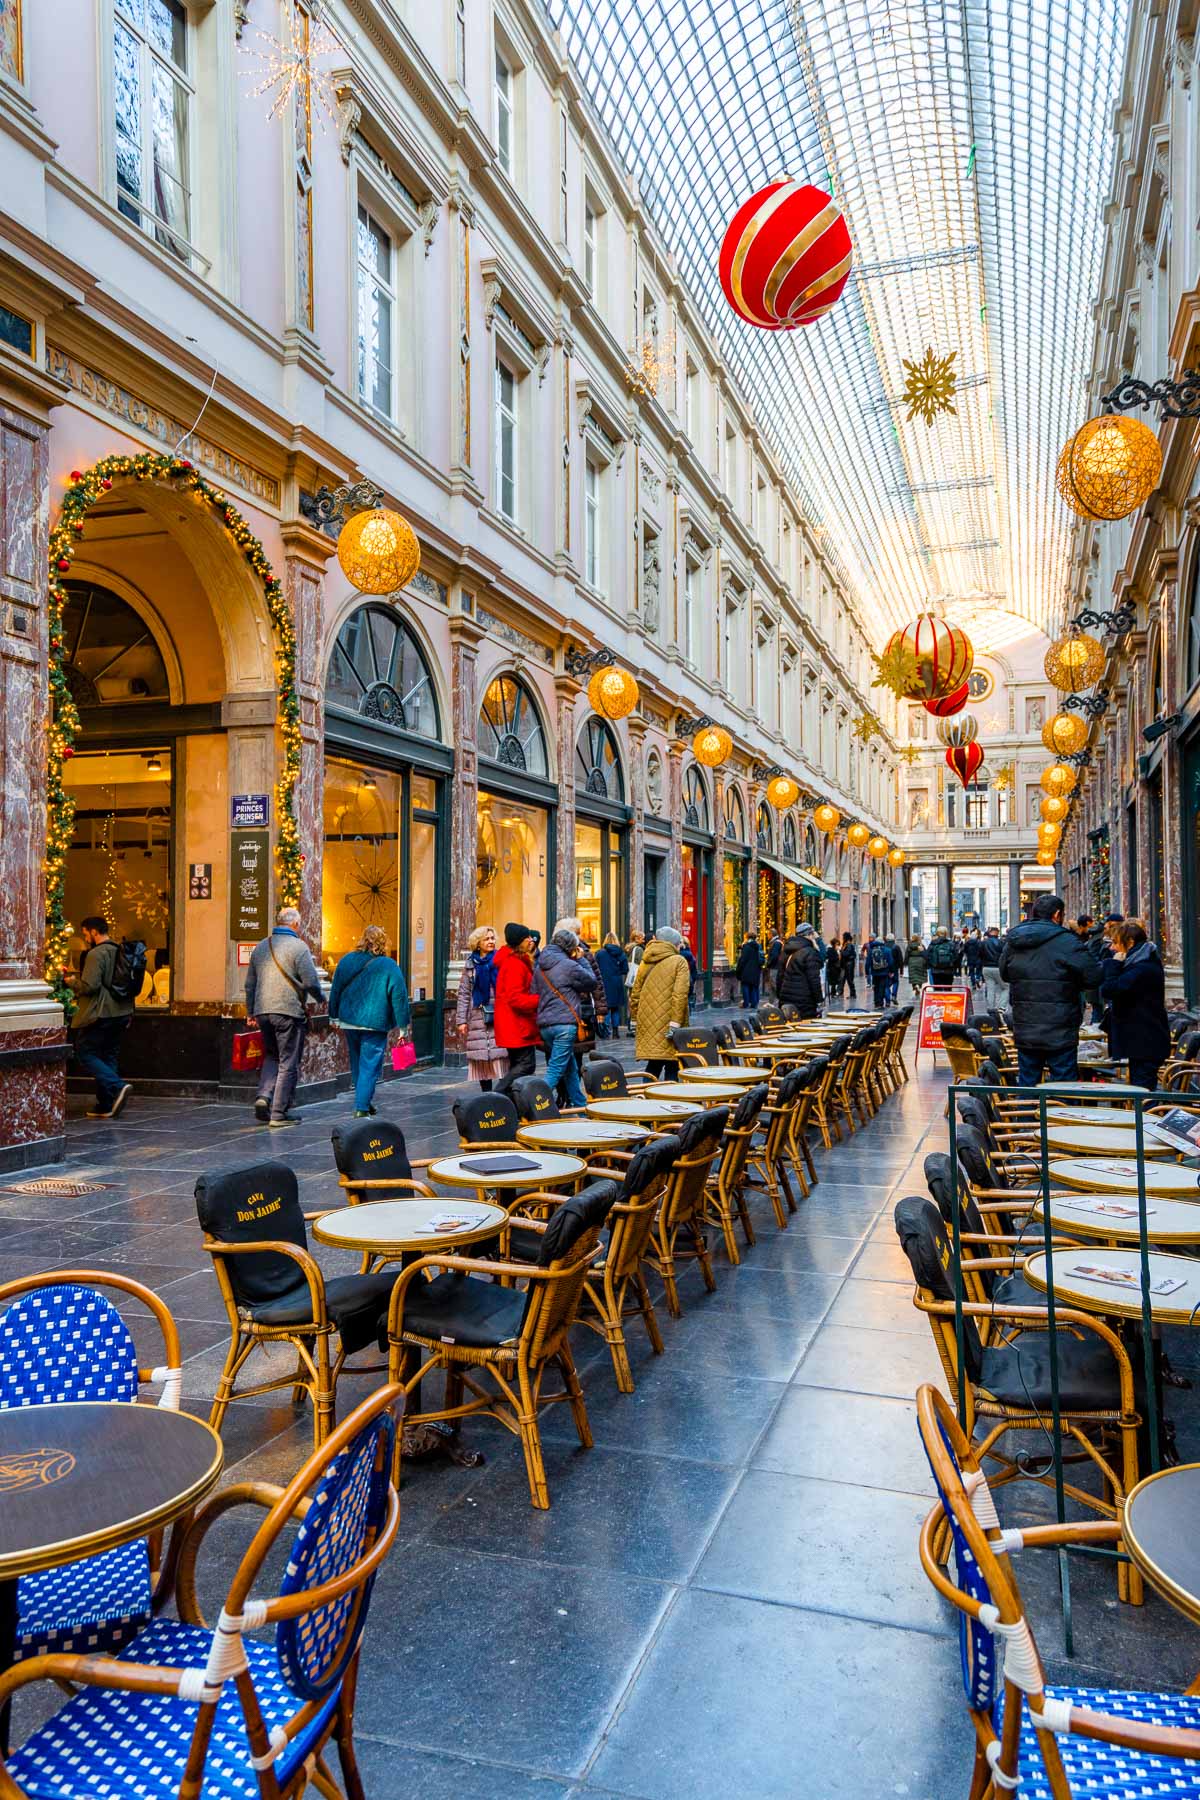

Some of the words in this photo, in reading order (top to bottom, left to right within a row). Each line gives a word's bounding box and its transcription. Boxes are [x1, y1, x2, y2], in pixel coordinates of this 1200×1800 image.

[47, 347, 162, 437] PASSAGE
[235, 804, 264, 813] PRINCES
[235, 812, 264, 821] PRINSEN
[369, 1139, 382, 1149] CAVA
[362, 1152, 376, 1162] DON
[247, 1192, 265, 1205] CAVA
[236, 1210, 256, 1222] DON
